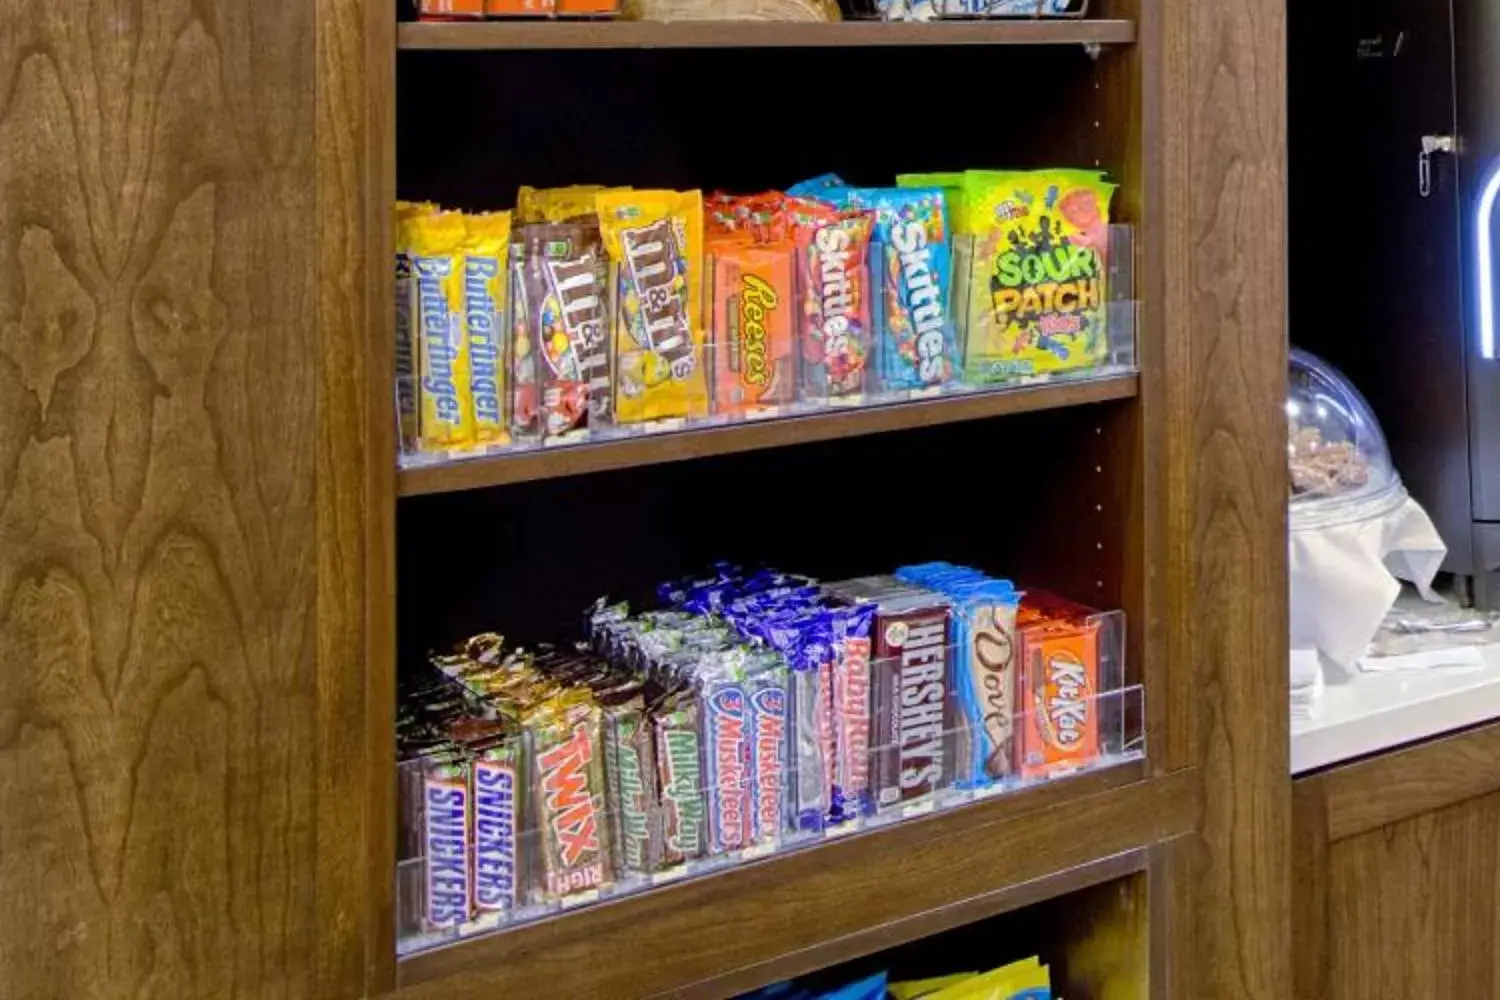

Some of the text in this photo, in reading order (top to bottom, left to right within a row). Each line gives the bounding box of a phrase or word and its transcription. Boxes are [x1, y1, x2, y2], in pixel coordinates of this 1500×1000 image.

[741, 274, 778, 386] Reese's
[814, 226, 851, 356] Skittles
[891, 219, 945, 383] Skittles
[993, 278, 1100, 315] PATCH
[997, 246, 1095, 287] SOUR
[412, 255, 460, 425] Butterfinger
[464, 255, 500, 425] Butterfinger
[898, 621, 945, 790] HERSHEY'S
[475, 767, 513, 910] SNICKERS
[715, 713, 744, 844] Musketeers
[427, 787, 467, 926] SNICKERS
